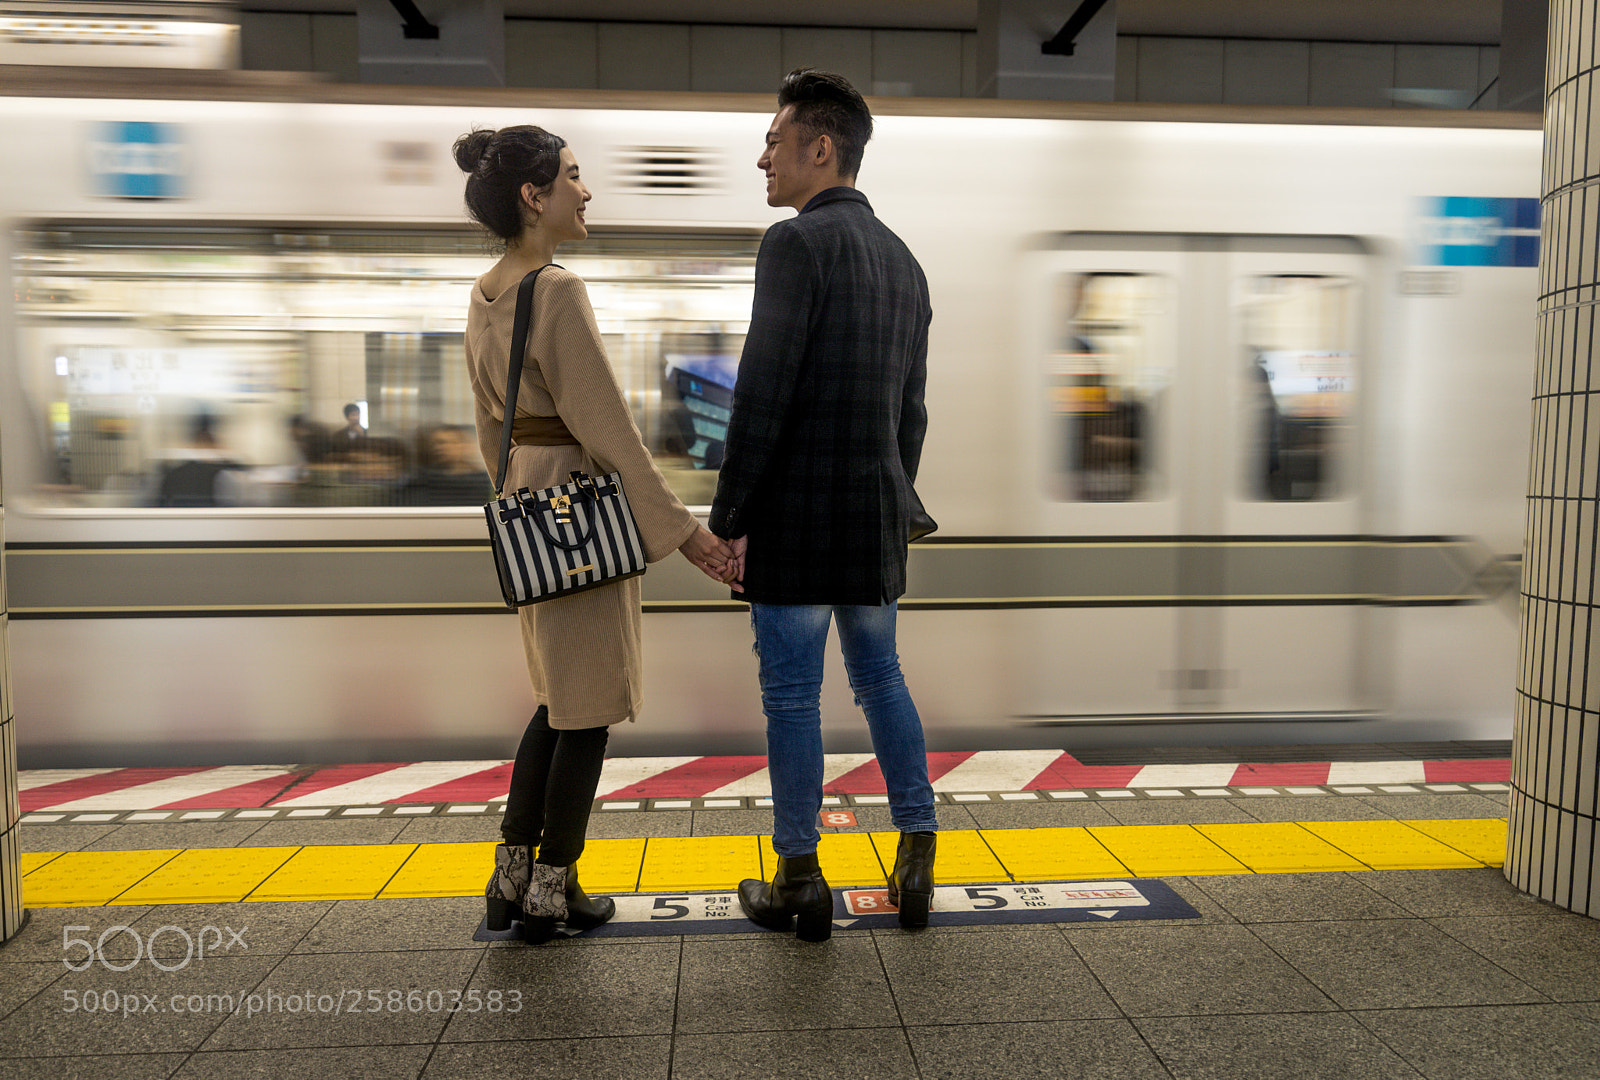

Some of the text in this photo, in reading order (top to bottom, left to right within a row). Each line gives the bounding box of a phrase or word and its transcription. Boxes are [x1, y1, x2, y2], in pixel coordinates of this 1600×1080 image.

[827, 813, 850, 824] 8
[856, 896, 878, 909] 8
[964, 888, 1008, 909] 5
[650, 897, 690, 920] 5
